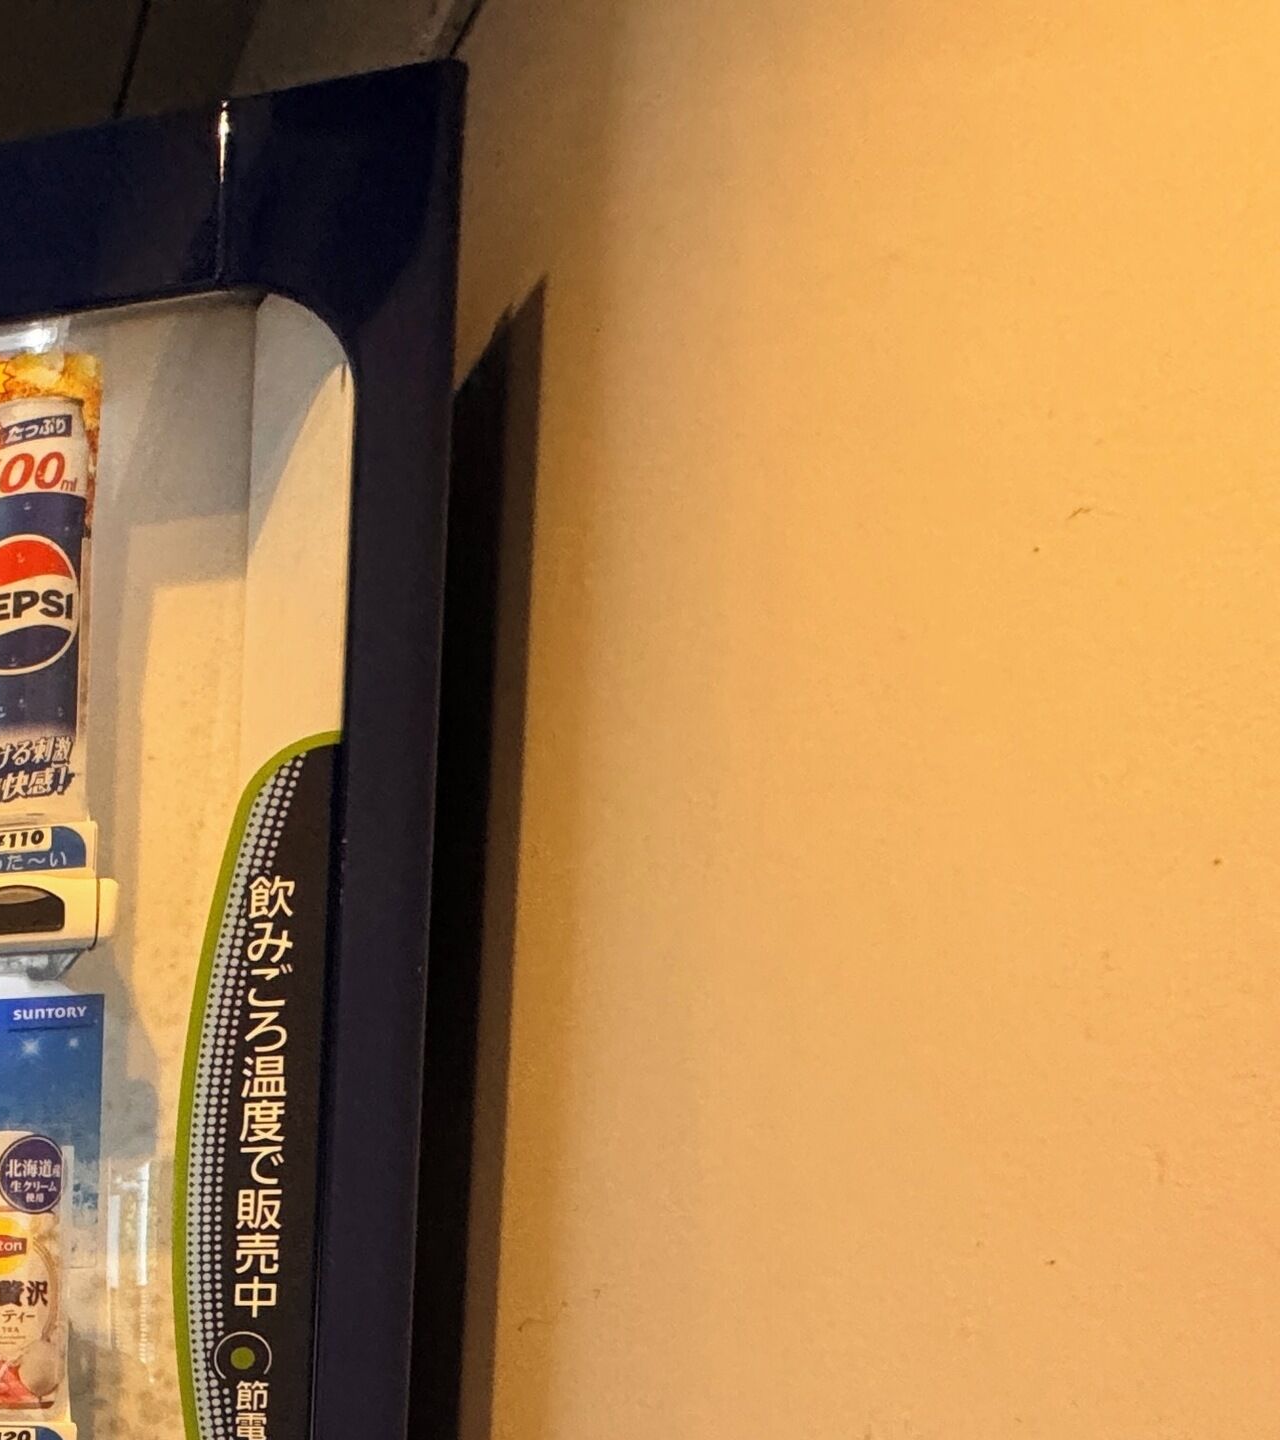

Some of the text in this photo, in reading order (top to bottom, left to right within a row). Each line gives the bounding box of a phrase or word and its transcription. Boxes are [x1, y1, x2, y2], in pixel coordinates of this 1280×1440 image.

[6, 416, 68, 443] たっぷり
[13, 1006, 88, 1021] SUNTORY
[232, 875, 295, 1320] 飲みごろ温度で販売中
